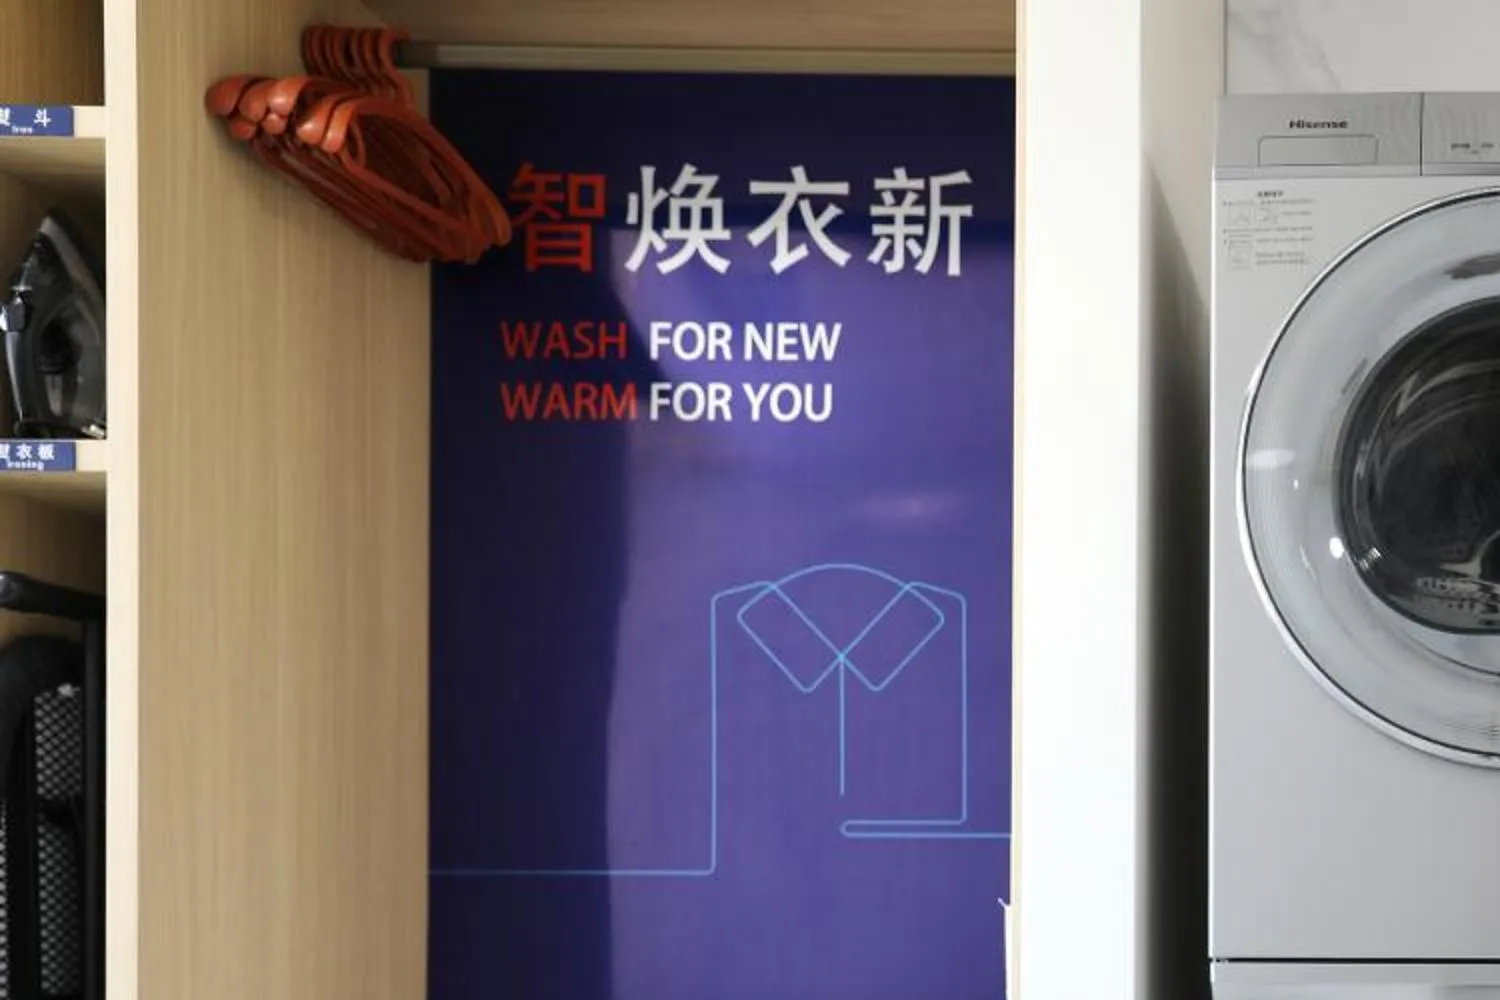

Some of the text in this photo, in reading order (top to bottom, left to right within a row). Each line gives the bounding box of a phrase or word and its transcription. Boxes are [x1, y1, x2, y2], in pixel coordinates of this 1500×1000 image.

[1289, 119, 1348, 129] Hisense
[508, 161, 974, 277] 智焕衣新
[501, 321, 842, 362] WASH FOR NEW
[501, 383, 834, 423] WARM FOR YOU
